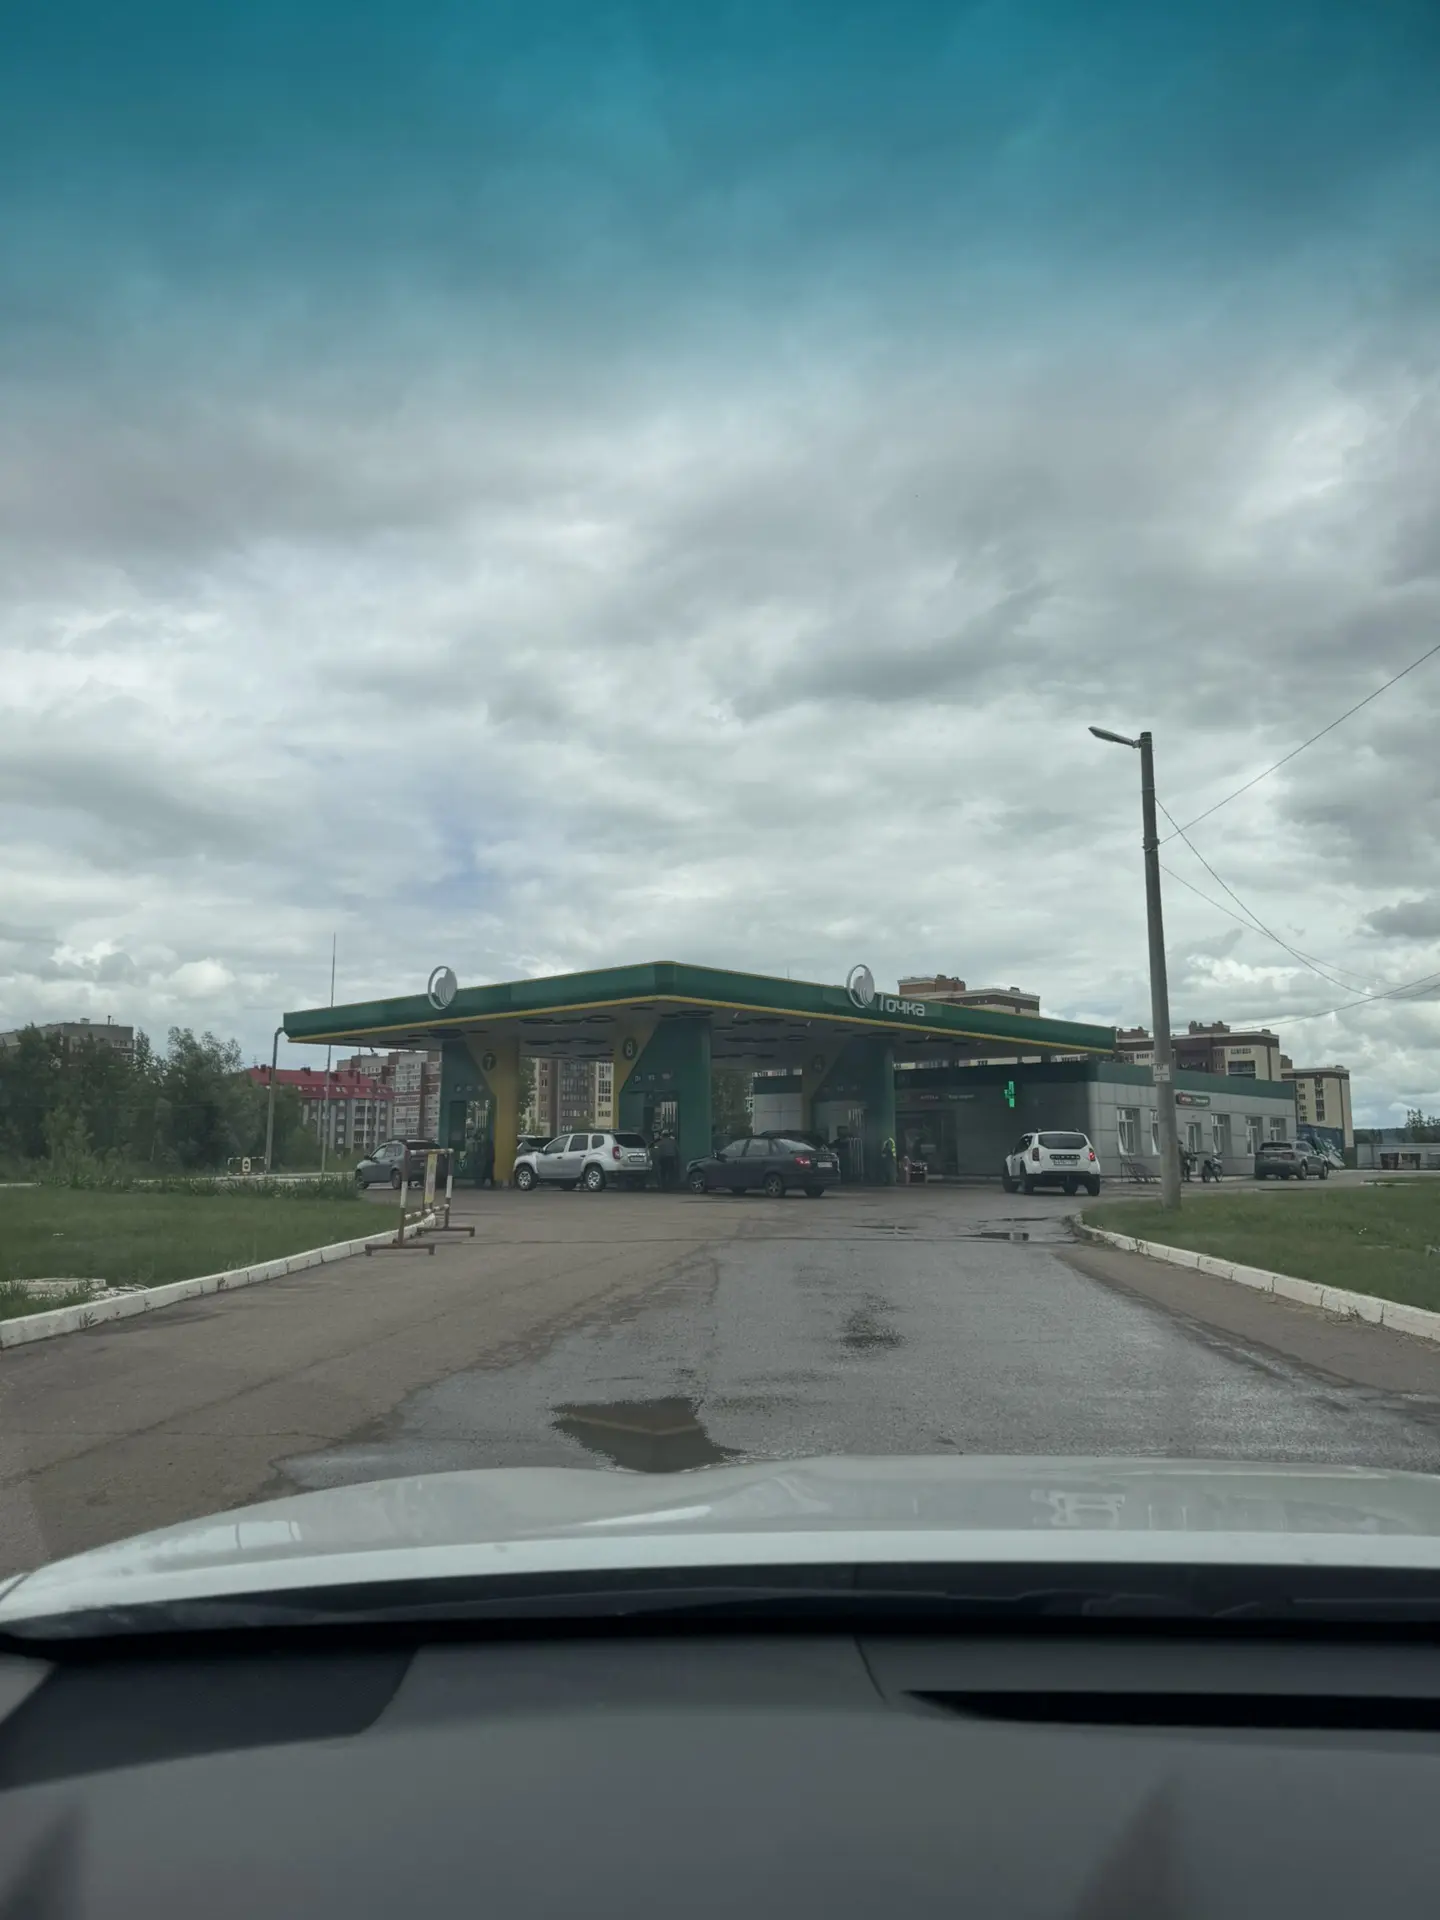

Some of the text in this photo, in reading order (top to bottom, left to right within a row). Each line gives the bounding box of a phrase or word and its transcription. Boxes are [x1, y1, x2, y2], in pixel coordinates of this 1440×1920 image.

[878, 993, 926, 1017] Точка
[625, 1041, 633, 1057] 8
[485, 1056, 492, 1070] 7
